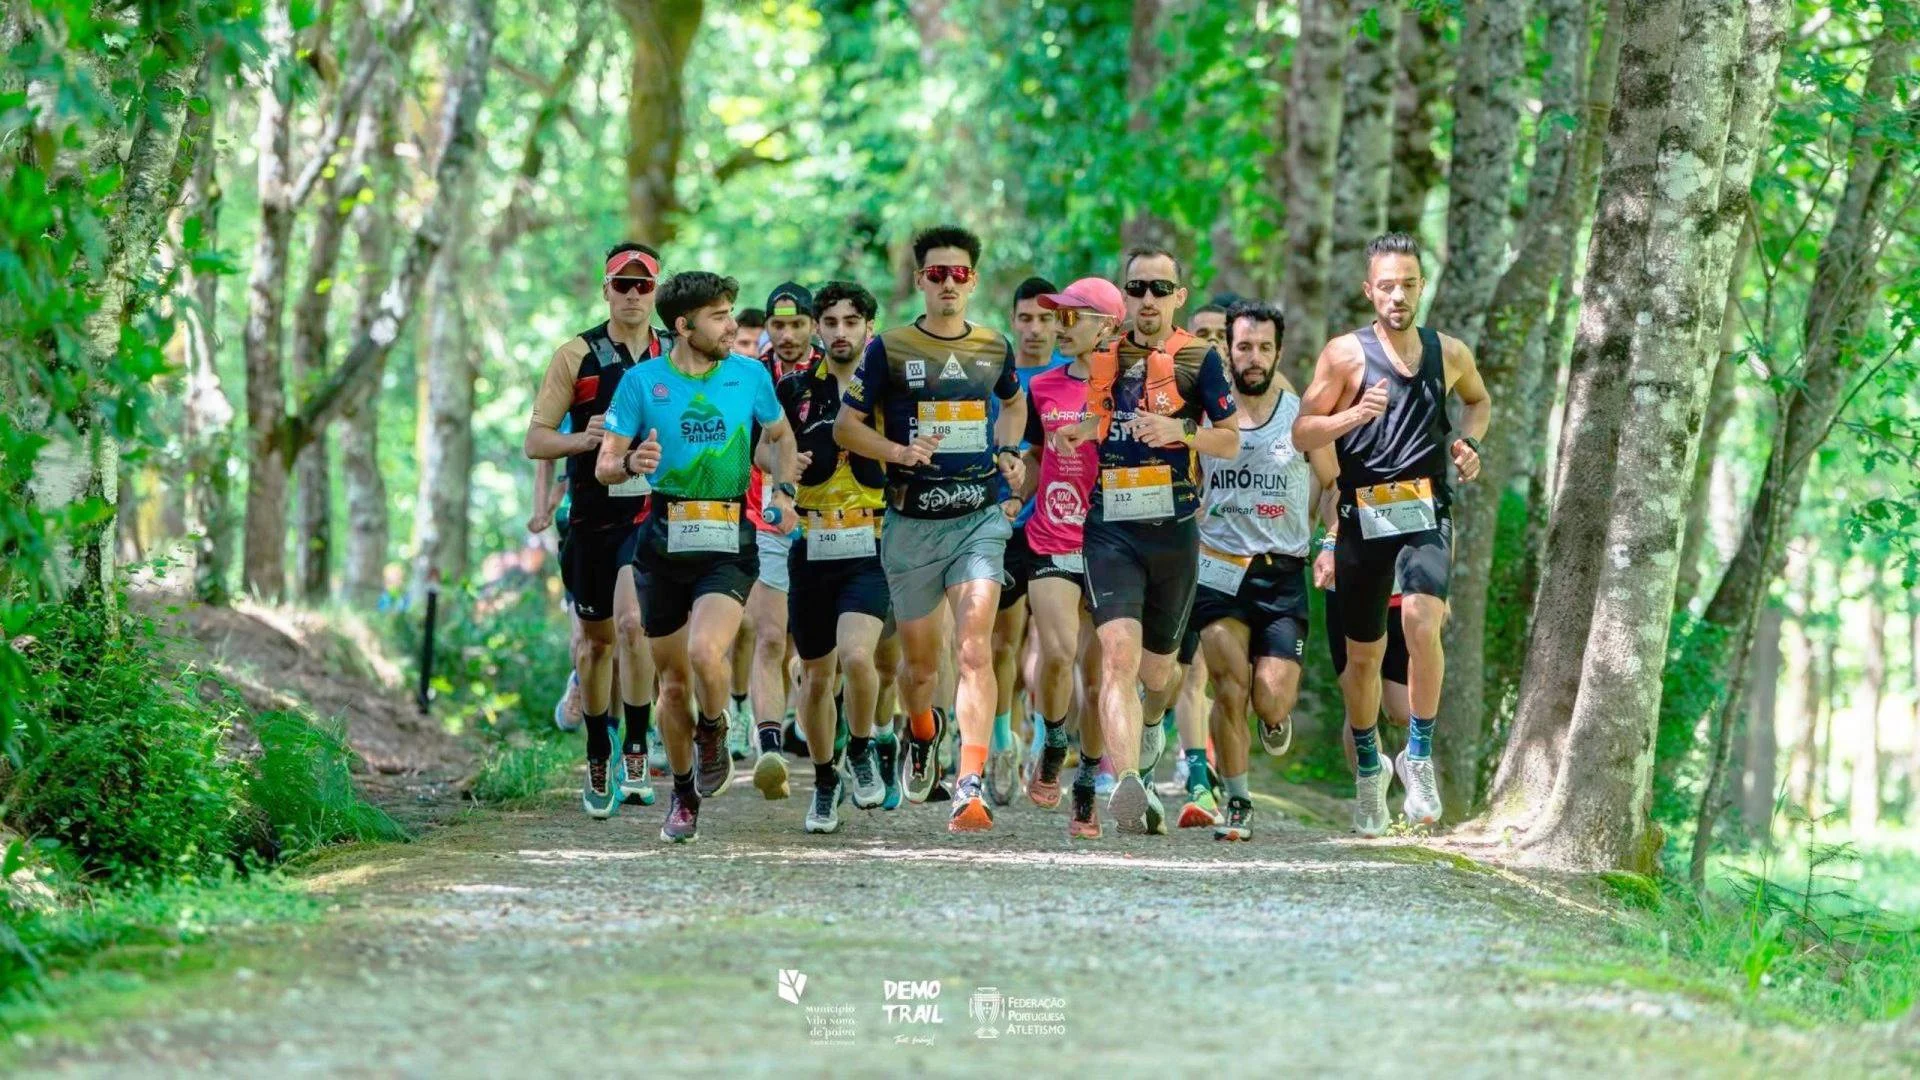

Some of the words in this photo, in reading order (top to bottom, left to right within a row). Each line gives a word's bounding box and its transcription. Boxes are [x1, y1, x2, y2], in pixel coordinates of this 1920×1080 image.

[681, 419, 726, 435] SACA
[932, 425, 951, 435] 108
[681, 432, 726, 443] TRILHOS
[1115, 493, 1132, 502] 112
[1375, 508, 1392, 518] 177
[681, 524, 700, 534] 225
[819, 533, 837, 542] 140
